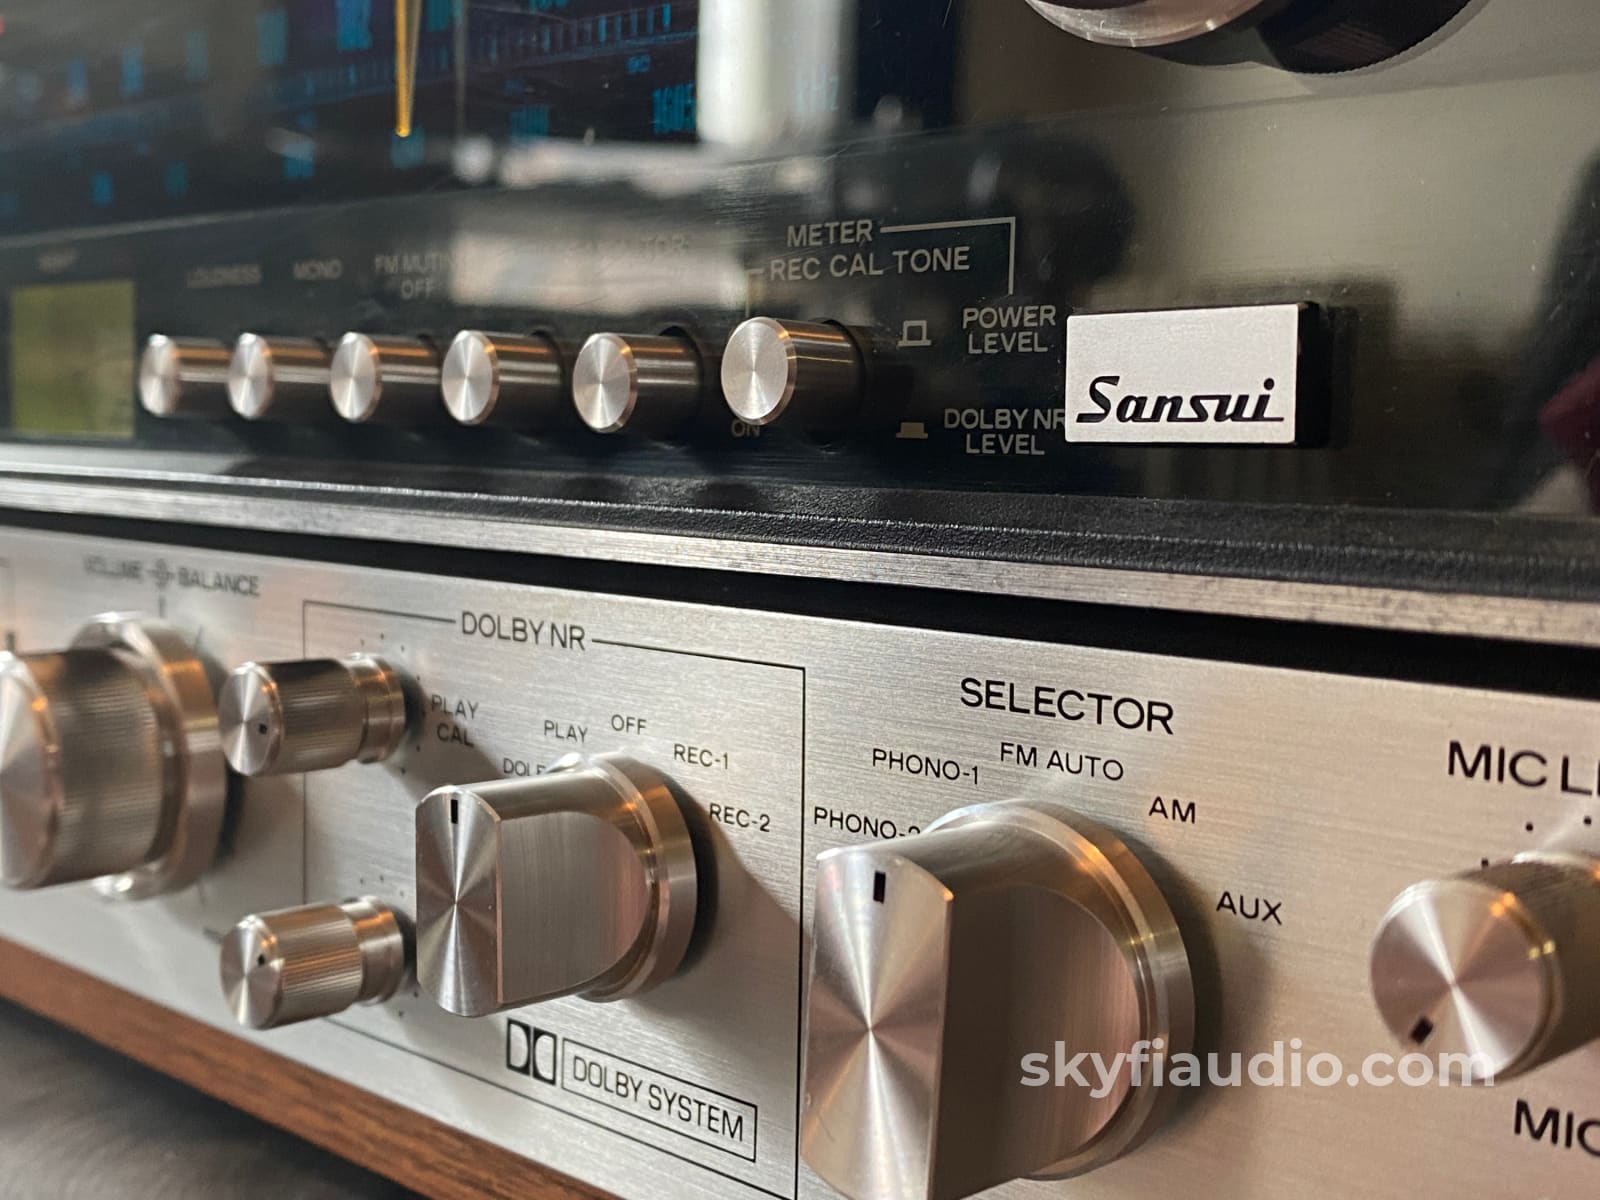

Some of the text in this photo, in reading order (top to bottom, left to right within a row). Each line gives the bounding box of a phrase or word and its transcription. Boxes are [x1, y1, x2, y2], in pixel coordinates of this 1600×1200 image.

[787, 219, 874, 248] METER
[770, 245, 970, 282] REC CAL TONE
[961, 305, 1056, 330] POWER
[967, 330, 1049, 354] LEVEL
[1076, 375, 1285, 424] Sansui
[943, 408, 1066, 431] DOLBY NR
[965, 433, 1046, 456] LEVEL
[177, 567, 260, 598] BALANCE
[461, 611, 586, 651] DOLBY NR
[431, 694, 479, 720] PLAY
[960, 677, 1174, 735] SELECTOR
[436, 722, 474, 747] CAL
[544, 719, 588, 743] PLAY
[610, 713, 647, 735] OFF
[673, 743, 729, 770] REC-1
[872, 747, 979, 786] PHONO-1
[1000, 742, 1124, 782] FM AUTO
[1448, 740, 1600, 798] MIC L
[709, 803, 772, 833] REC-2
[1149, 796, 1197, 824] AM
[1216, 891, 1283, 926] AUX
[572, 1055, 744, 1143] DOLBY SYSTEM
